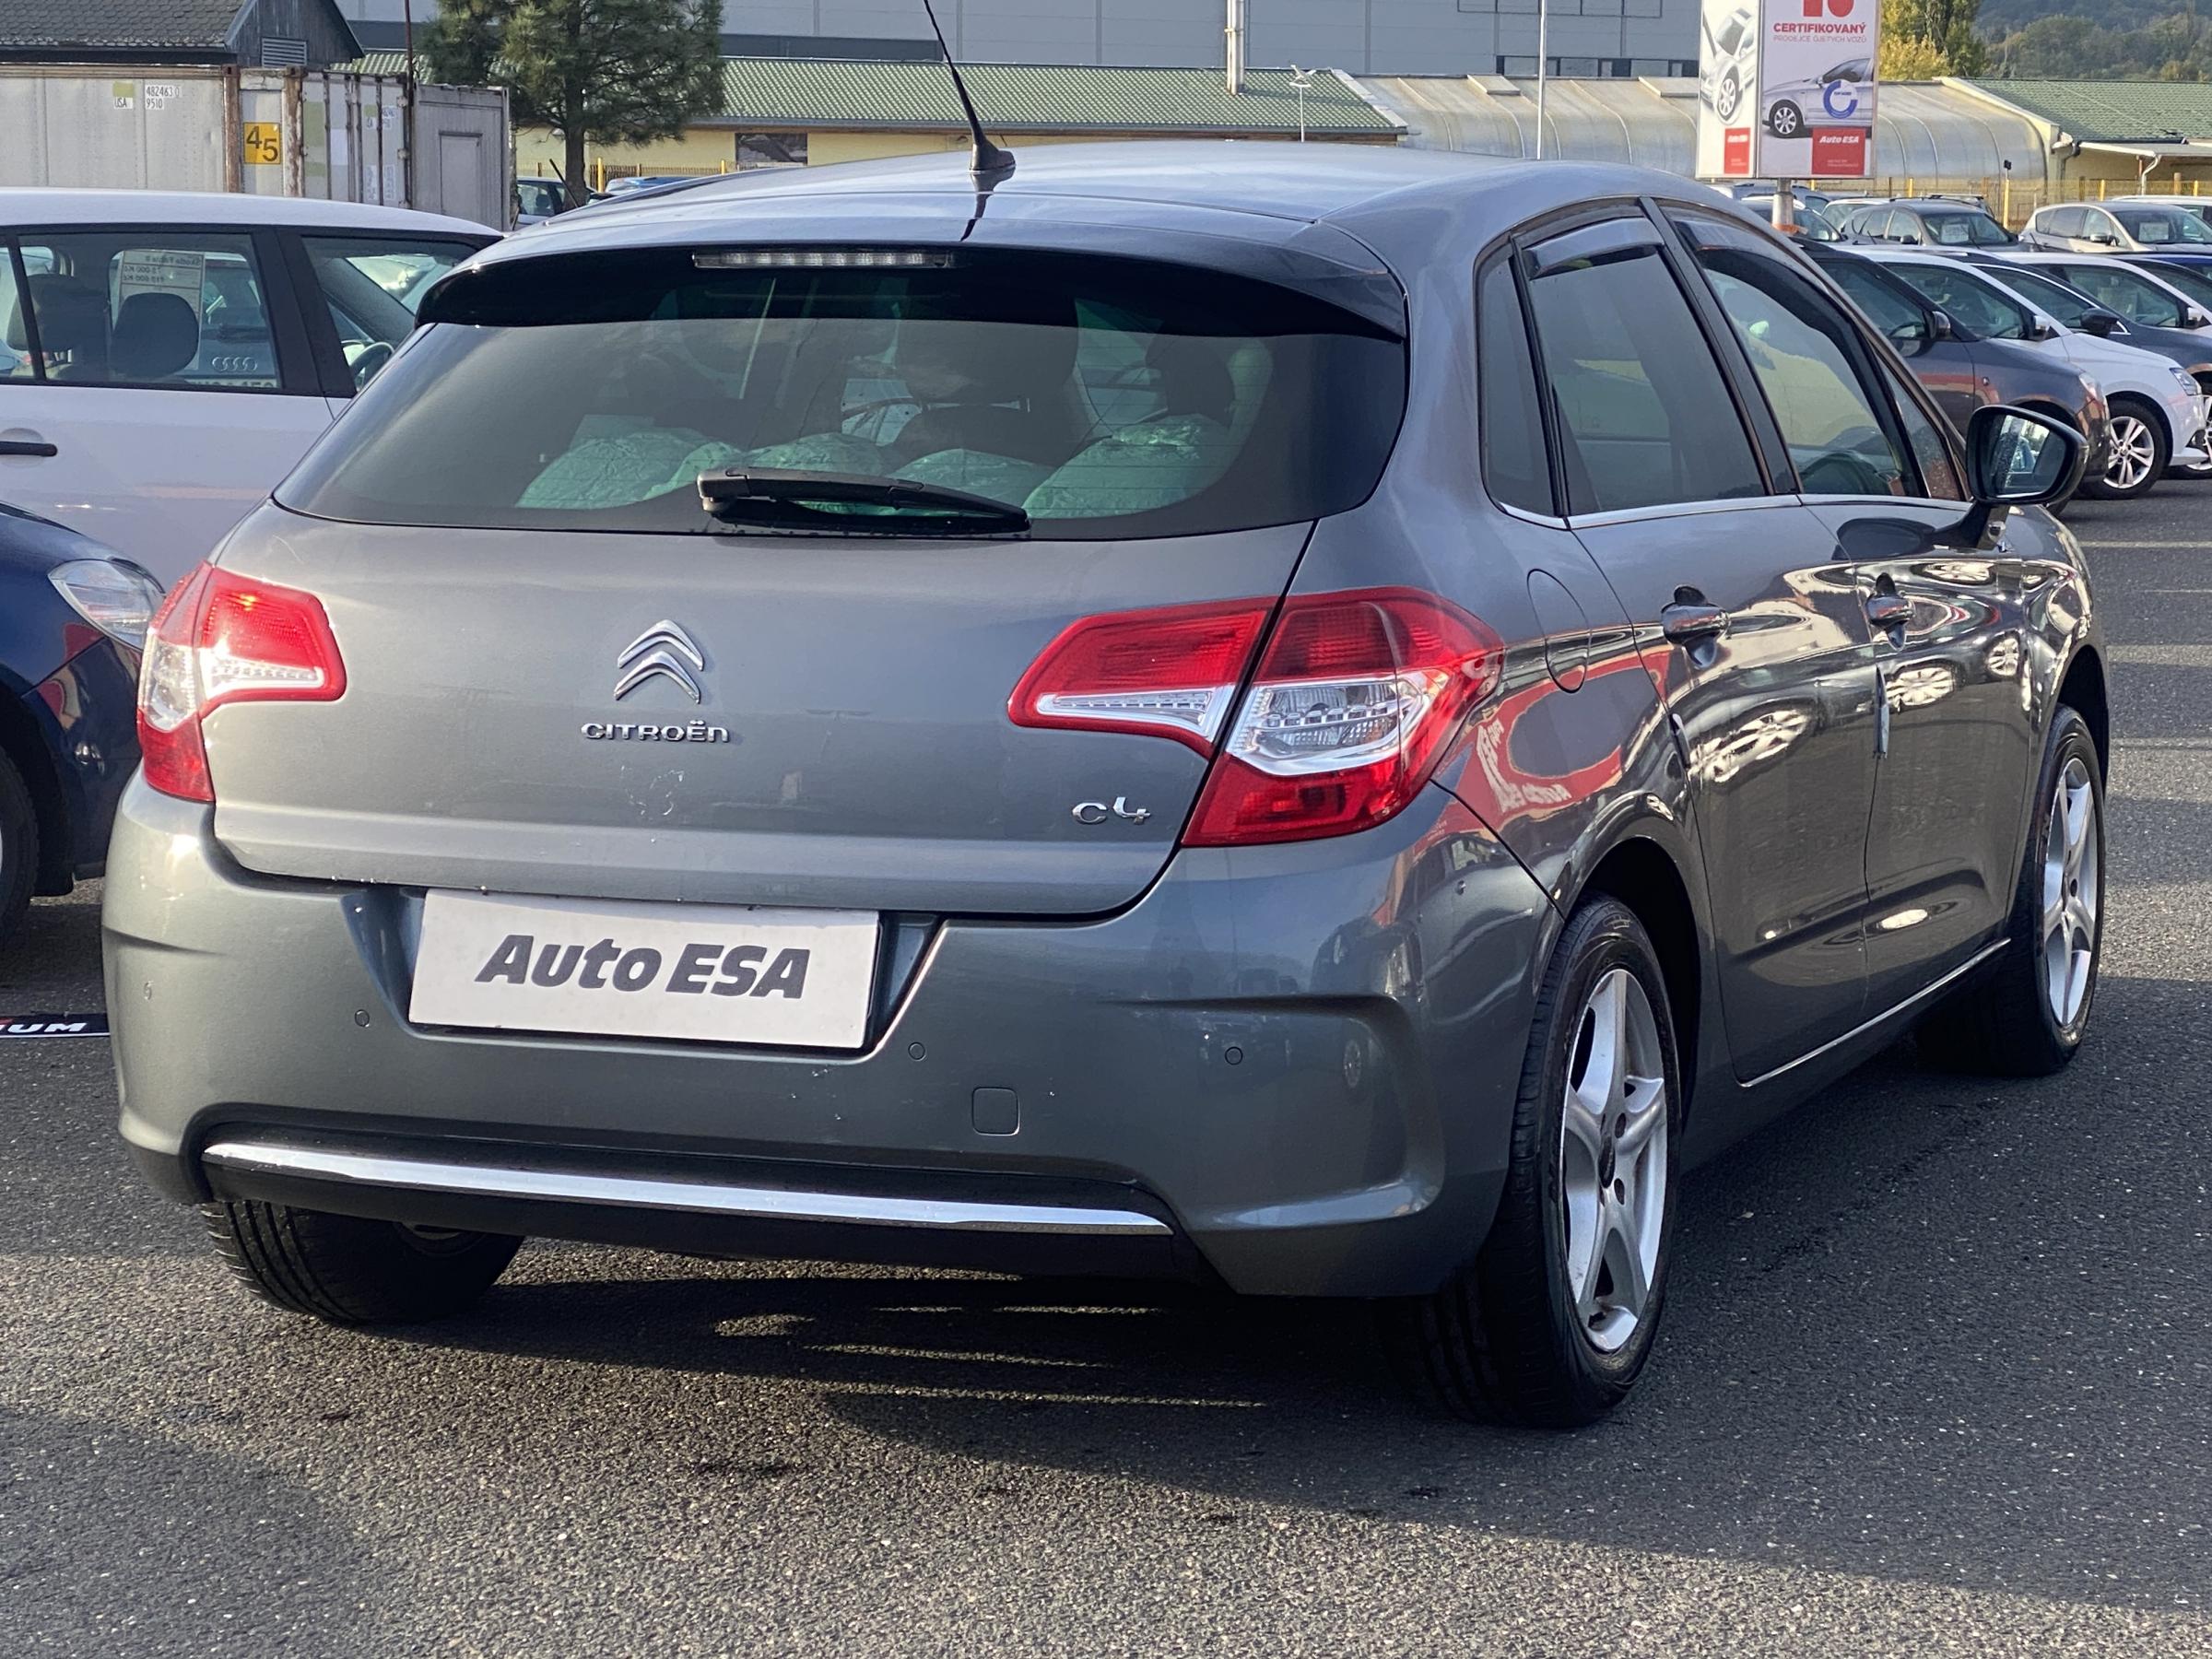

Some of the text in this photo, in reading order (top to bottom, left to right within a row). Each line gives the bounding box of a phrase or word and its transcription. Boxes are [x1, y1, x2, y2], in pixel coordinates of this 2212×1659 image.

[1773, 22, 1866, 33] CERTIFIKOVANÝ
[147, 86, 173, 97] 482463
[115, 97, 127, 108] USA
[147, 98, 163, 109] 9510
[246, 125, 278, 162] 45
[1819, 135, 1859, 144] Auto ESA
[475, 935, 810, 999] Auto ESA
